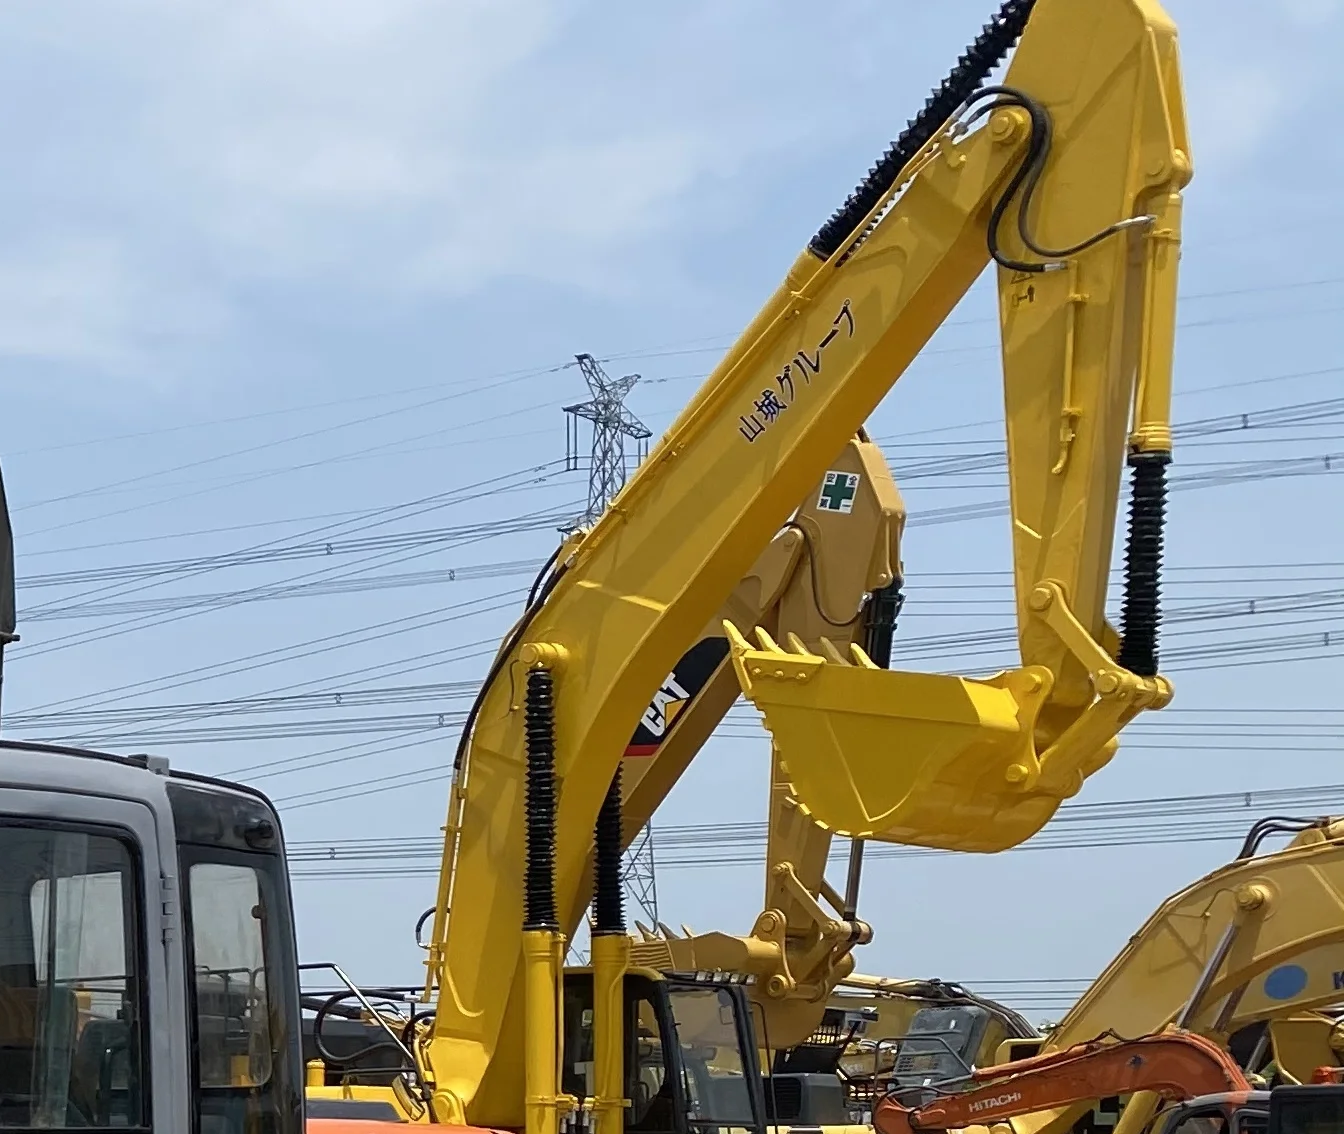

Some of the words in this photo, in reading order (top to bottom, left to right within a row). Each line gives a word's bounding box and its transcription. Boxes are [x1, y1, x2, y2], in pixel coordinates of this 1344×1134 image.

[739, 299, 854, 442] 山城グループ
[640, 672, 691, 737] CAT
[968, 1092, 1022, 1113] HITACHI
